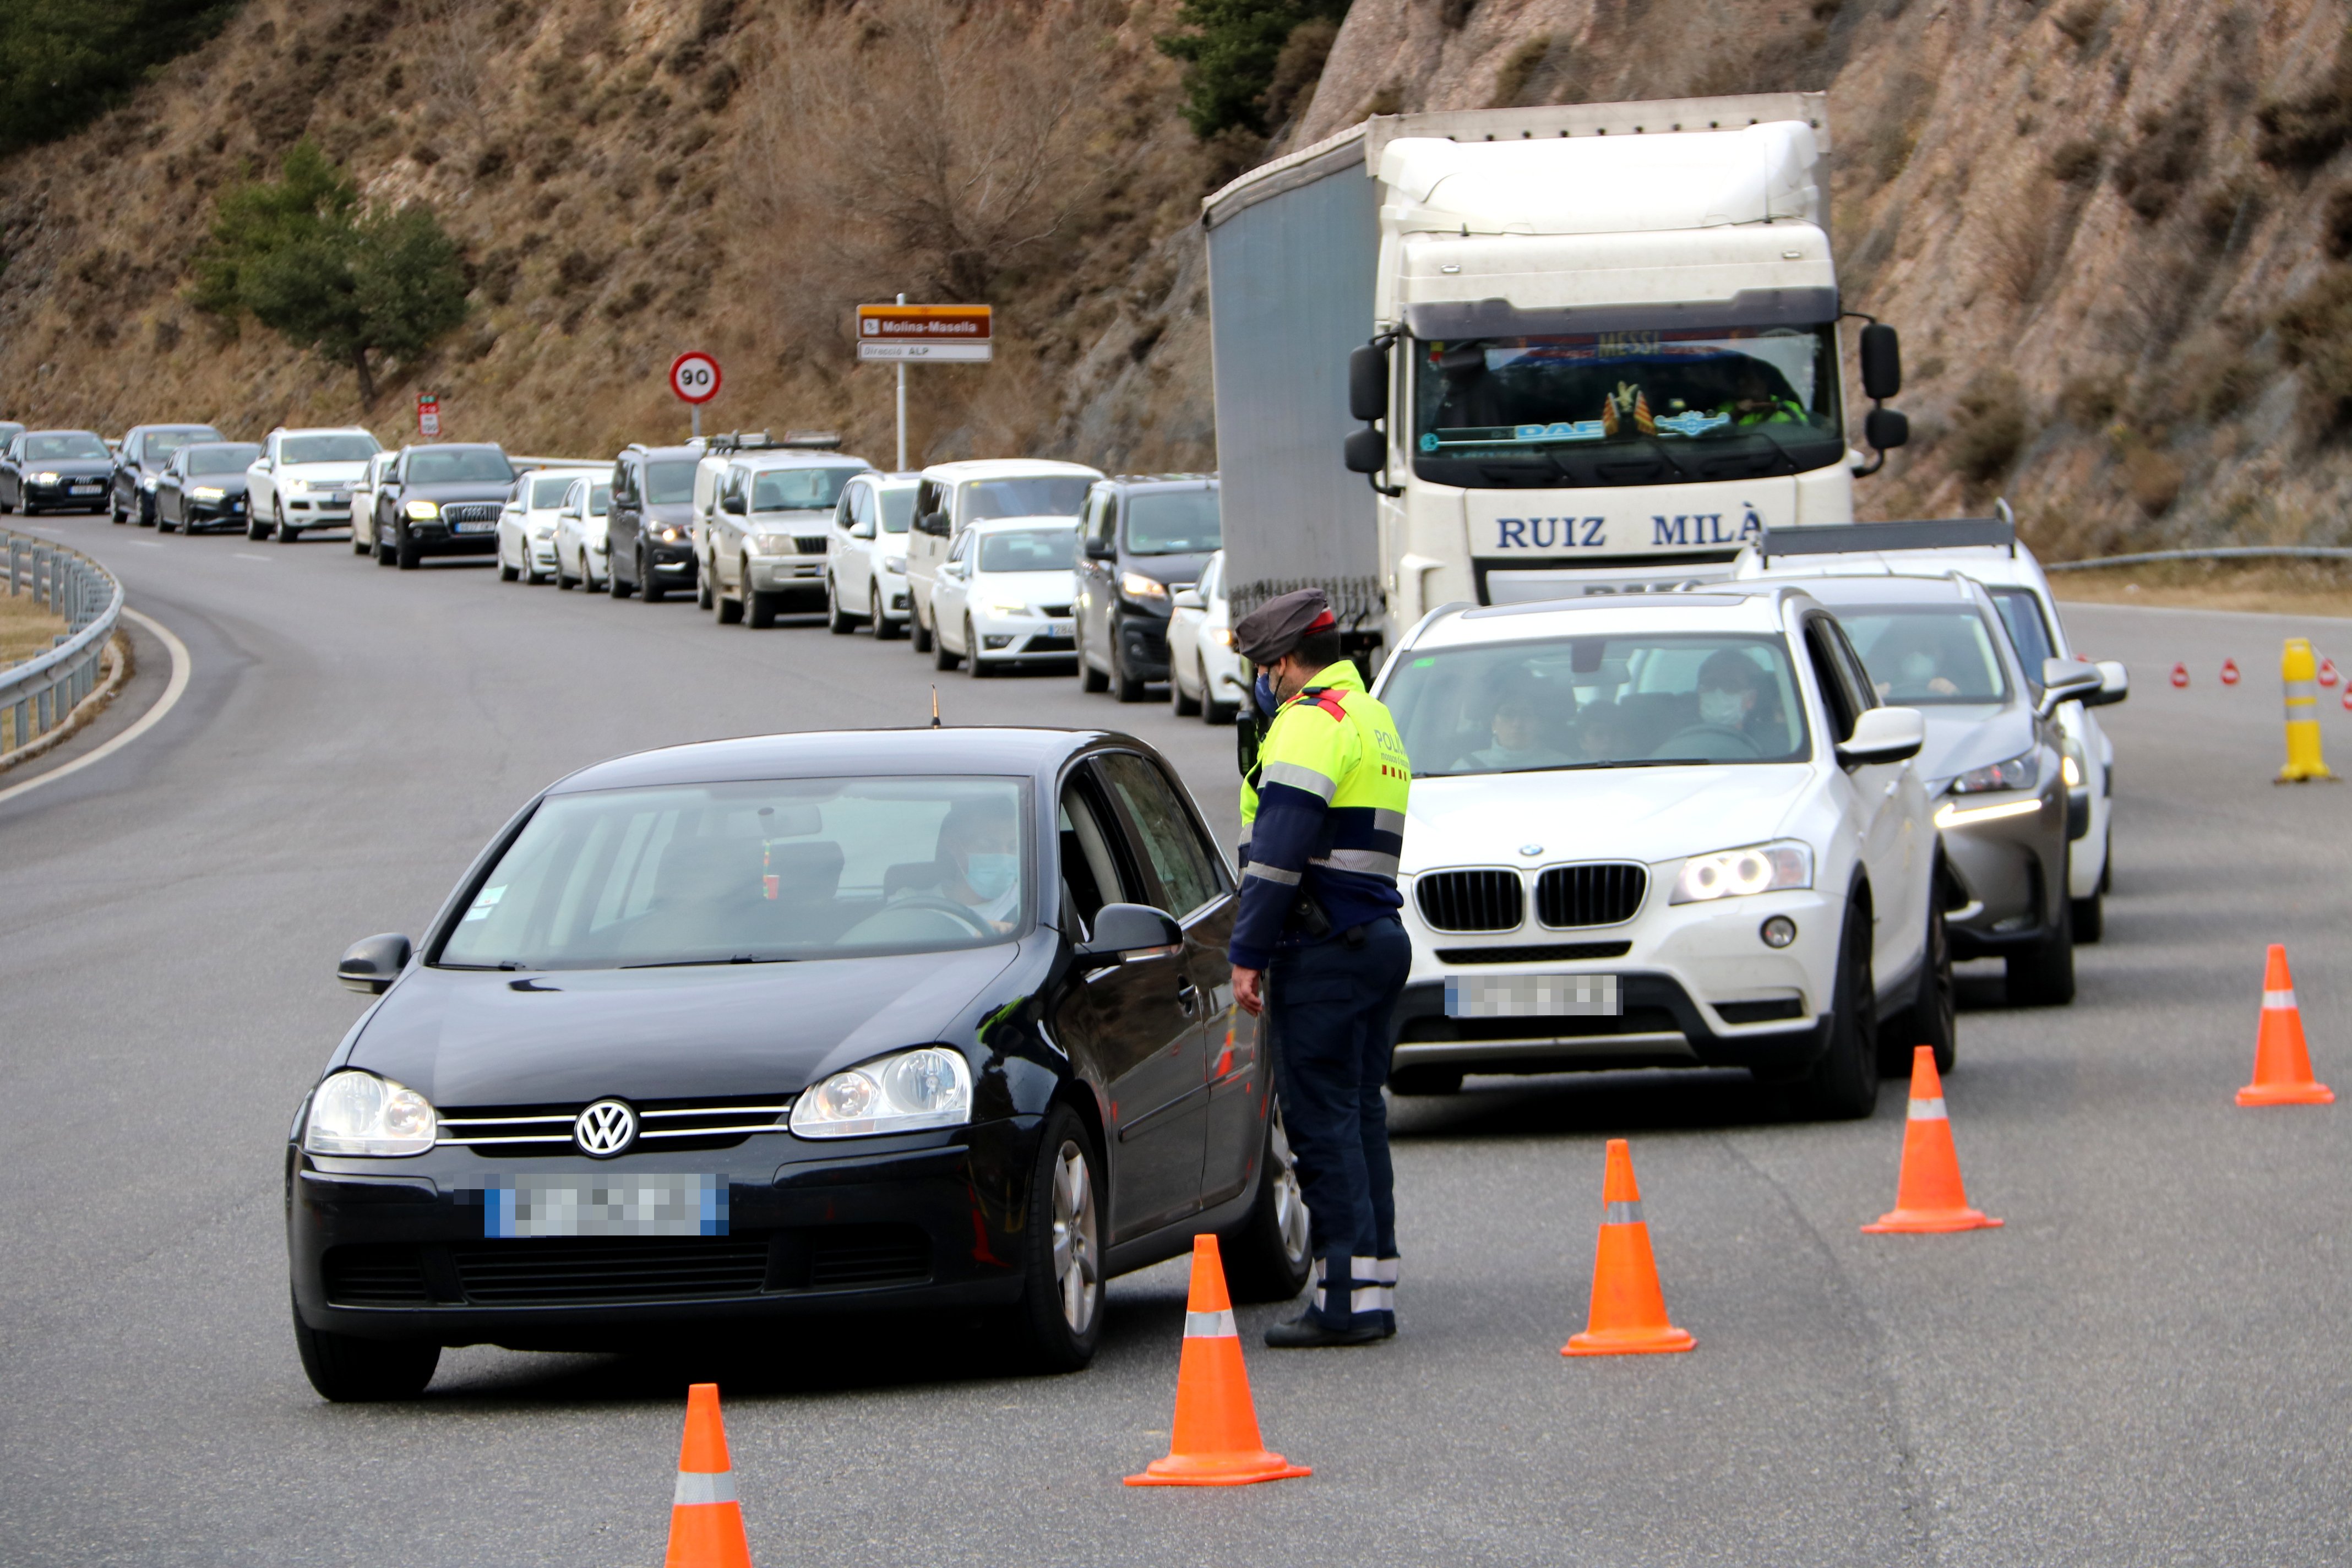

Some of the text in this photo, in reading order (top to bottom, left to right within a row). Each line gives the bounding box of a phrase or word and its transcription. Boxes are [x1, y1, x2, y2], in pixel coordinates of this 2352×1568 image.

[882, 321, 977, 333] Molina-Masella
[864, 346, 929, 355] Direcció ALP
[1598, 331, 1660, 357] MESSI
[682, 369, 709, 385] 90
[1515, 420, 1605, 440] DAF
[1496, 501, 1762, 548] RUIZ MILÀ
